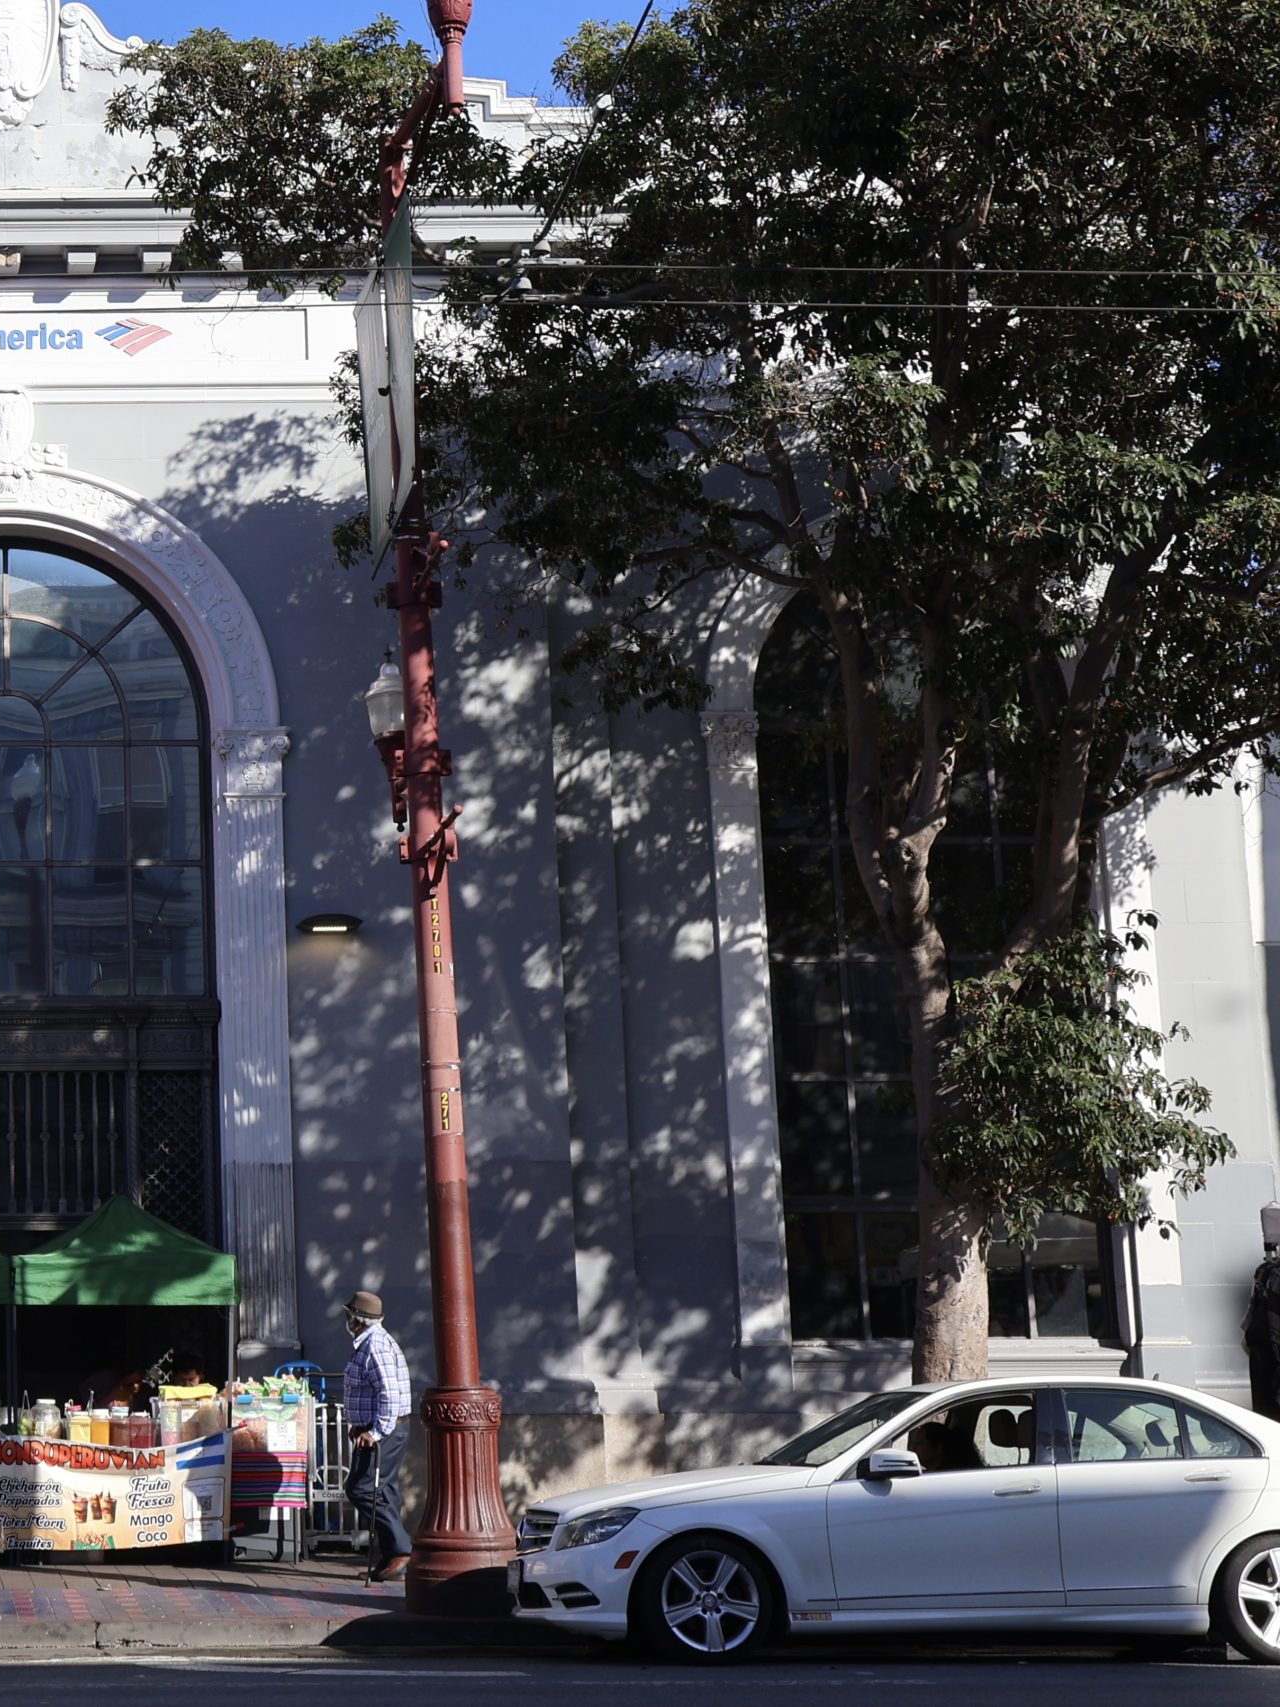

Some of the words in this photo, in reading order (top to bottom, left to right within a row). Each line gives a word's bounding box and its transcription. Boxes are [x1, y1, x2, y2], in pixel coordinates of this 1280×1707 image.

[131, 1477, 169, 1492] Fruta
[128, 1493, 174, 1508] Fresca
[129, 1513, 173, 1527] Mango
[6, 1535, 53, 1550] Esquites
[136, 1531, 168, 1543] Coco
